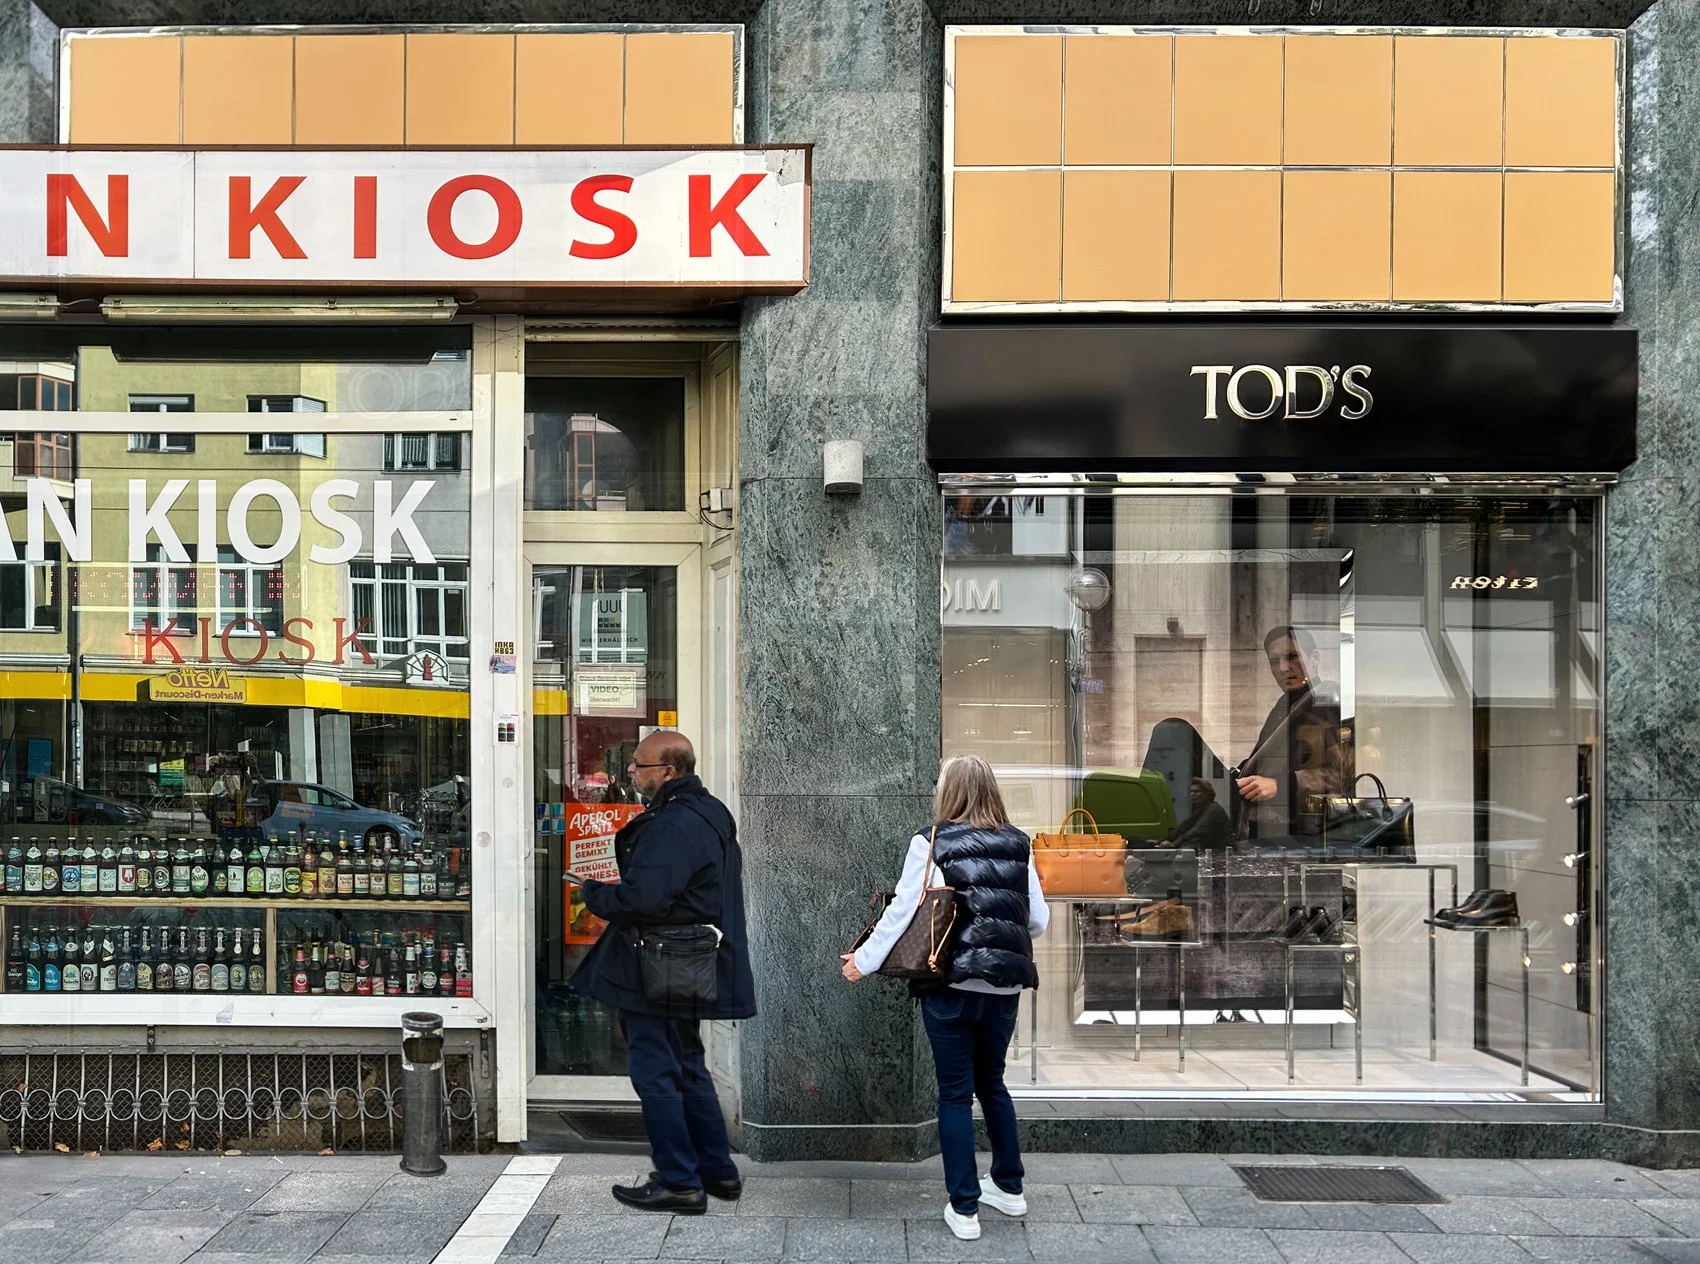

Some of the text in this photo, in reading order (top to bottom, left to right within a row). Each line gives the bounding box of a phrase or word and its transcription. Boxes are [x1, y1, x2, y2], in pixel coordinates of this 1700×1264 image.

[46, 173, 771, 260] N KIOSK
[1190, 363, 1374, 421] TOD'S
[128, 477, 437, 566] KIOSK
[141, 616, 376, 665] KIOSK
[590, 685, 619, 693] VIDEO
[569, 809, 621, 830] APEROL
[578, 821, 613, 836] SPRITZ
[575, 838, 612, 851] PERFEKT
[575, 847, 609, 859] GEMIXT
[575, 861, 613, 873] GEKÜHLT
